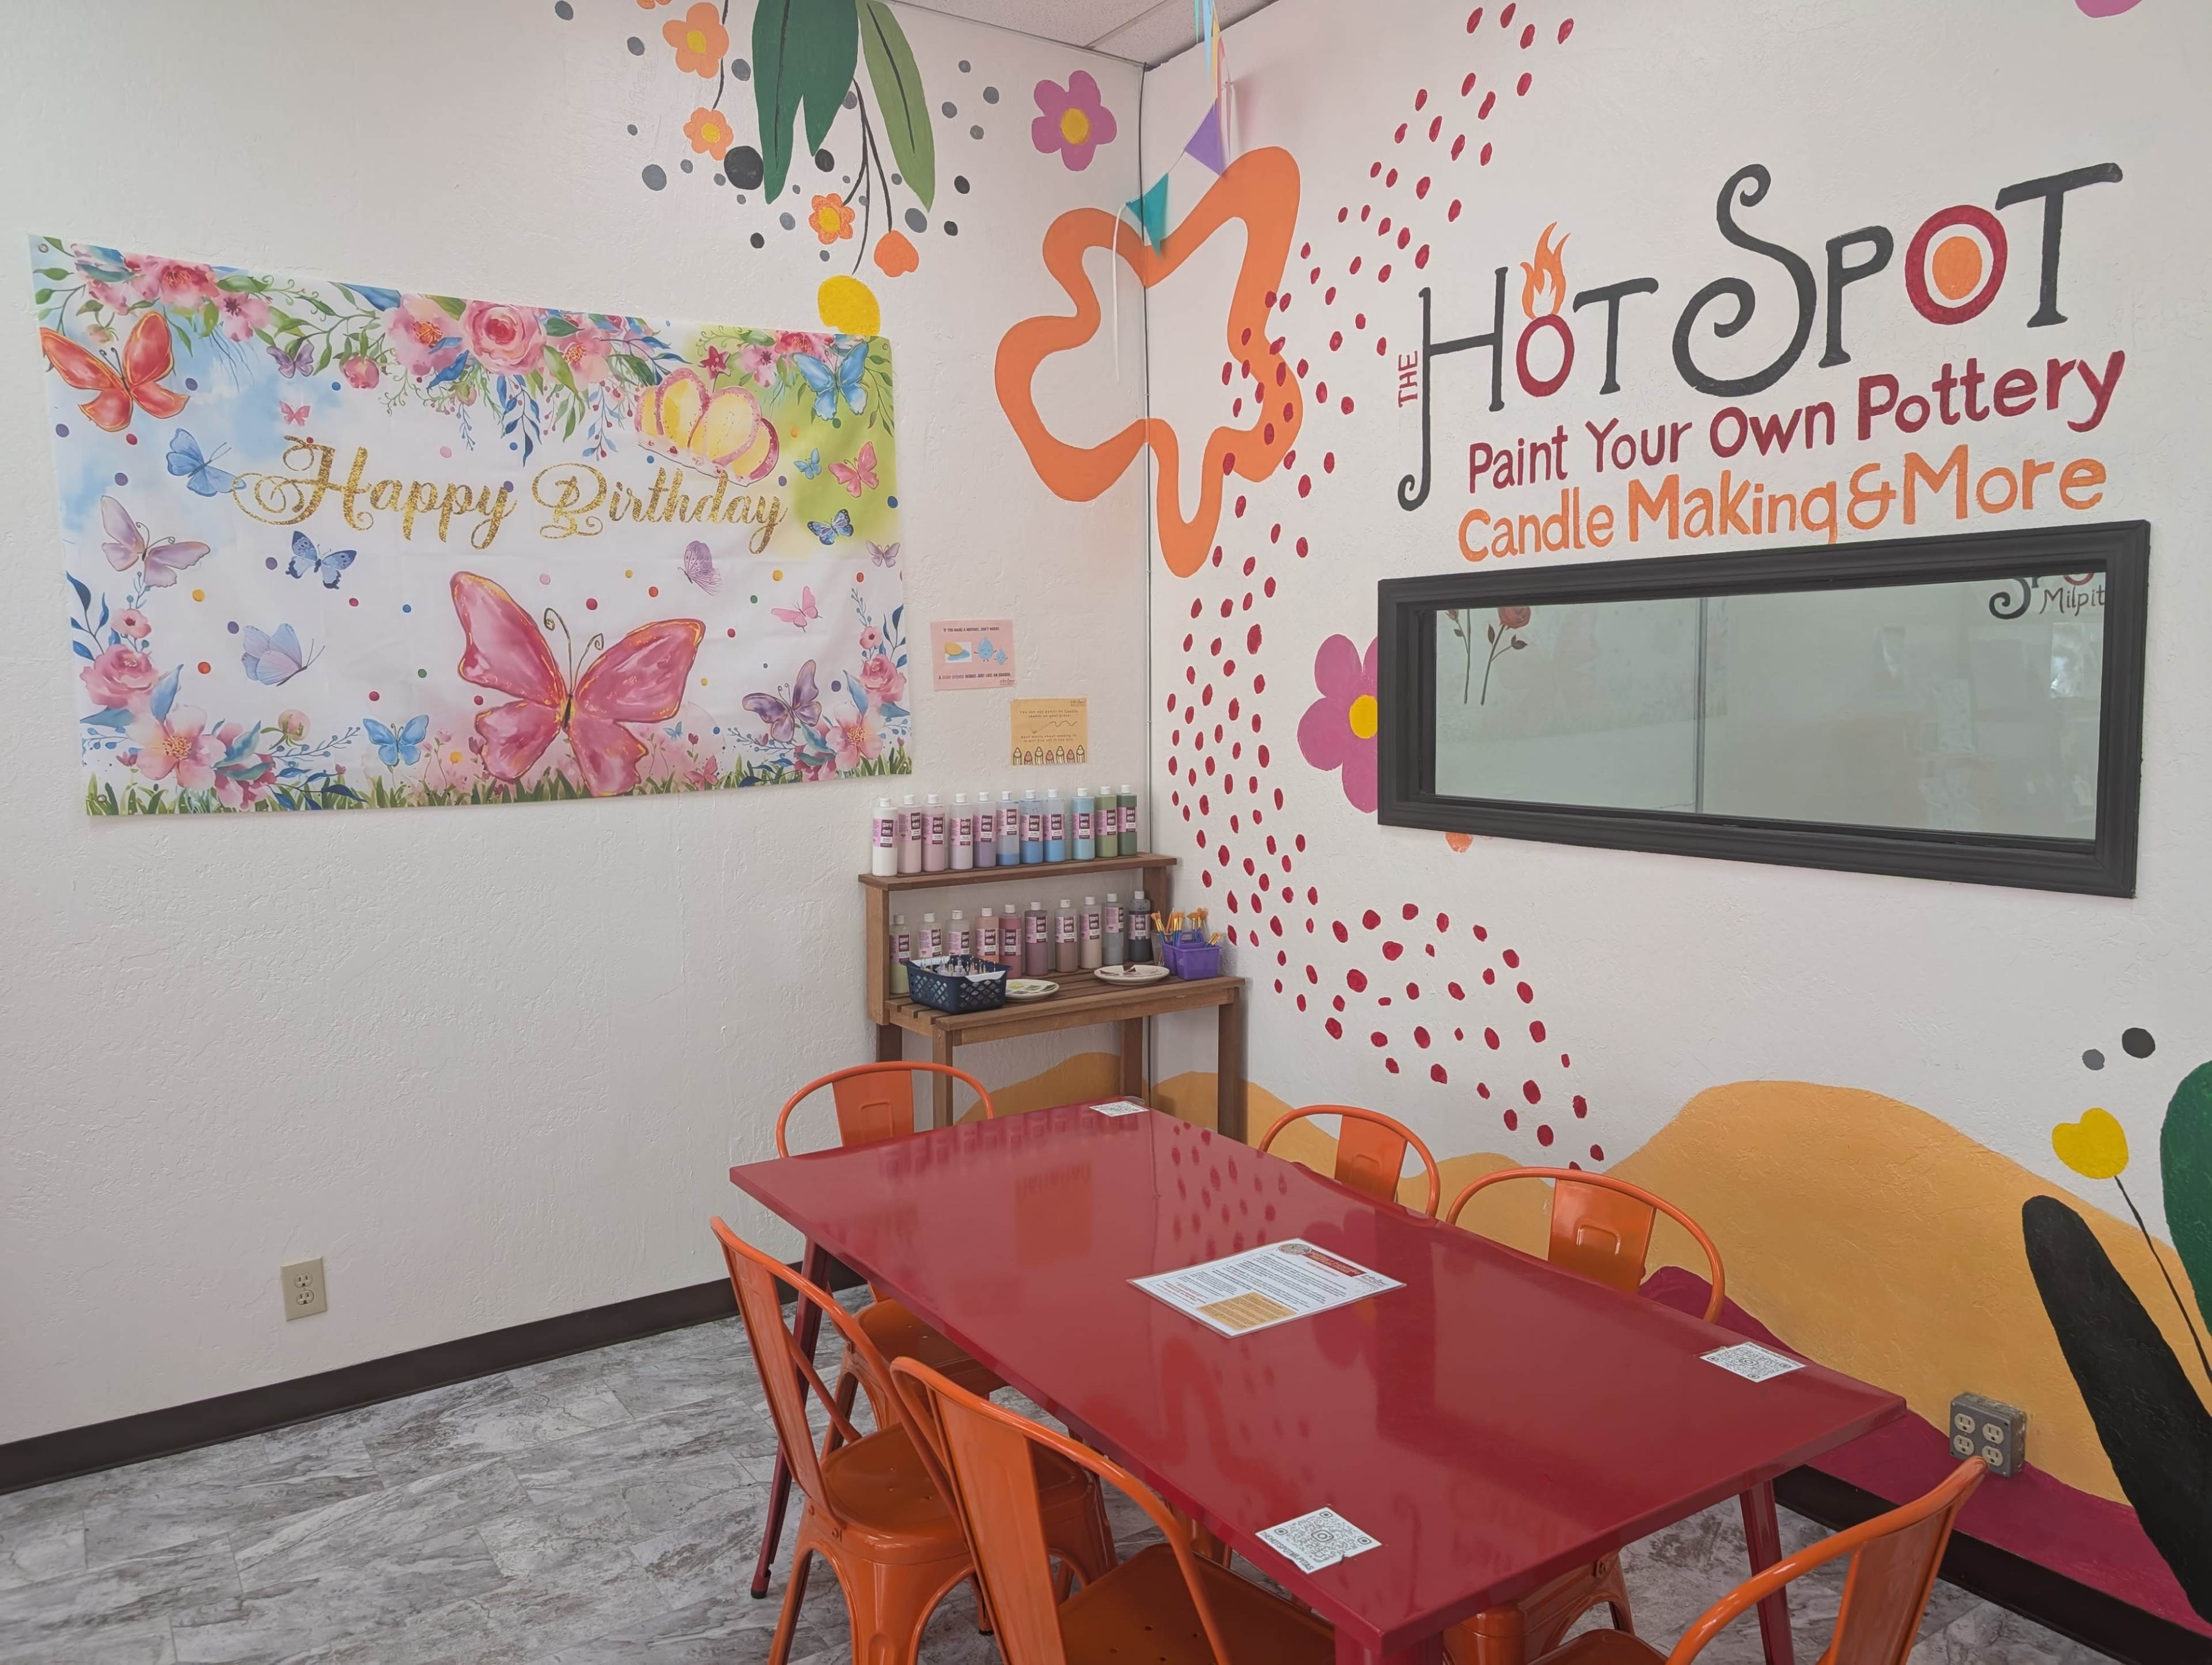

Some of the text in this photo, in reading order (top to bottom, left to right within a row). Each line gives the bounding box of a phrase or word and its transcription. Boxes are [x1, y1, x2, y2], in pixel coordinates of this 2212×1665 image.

[1397, 162, 2124, 511] THE HOT SPOT
[1469, 350, 2126, 494] Paint Your Own Pottery
[232, 434, 788, 555] Happy Birthday
[1457, 488, 1615, 563] Candle
[1628, 469, 1838, 545] Making
[1904, 444, 2107, 524] More
[2040, 585, 2105, 616] Milpit
